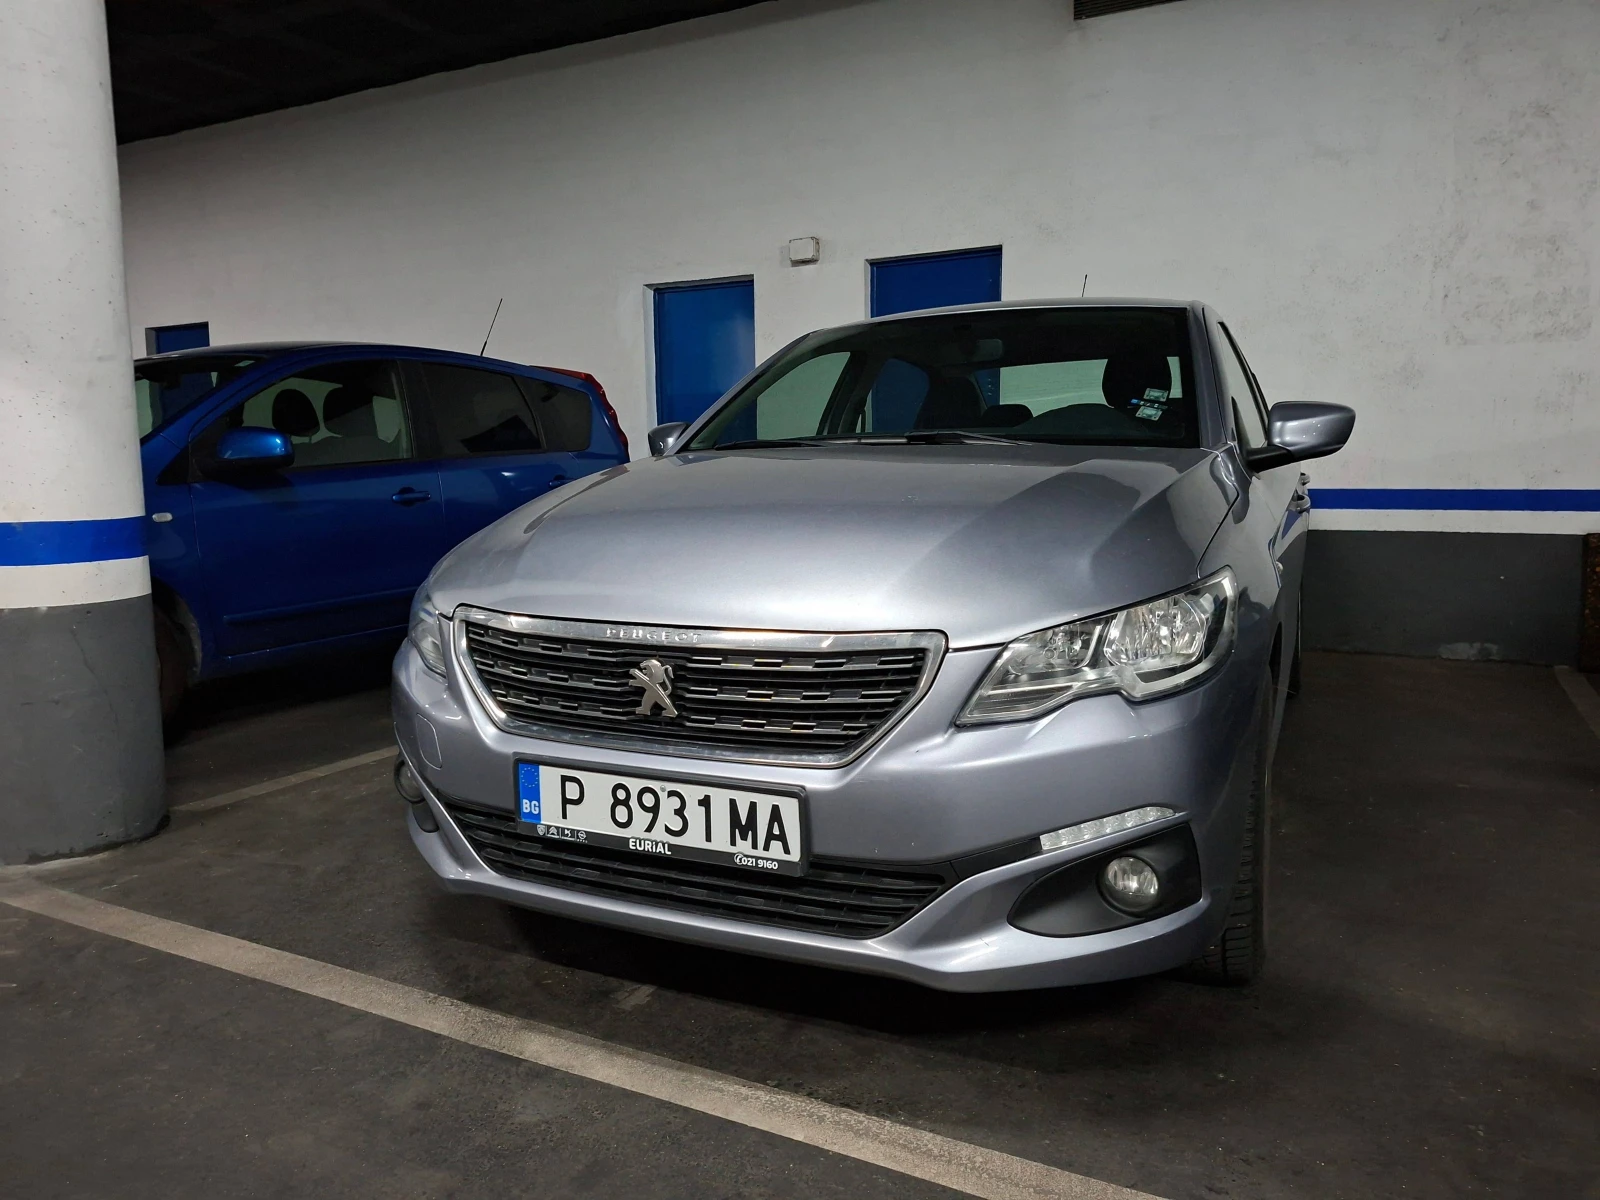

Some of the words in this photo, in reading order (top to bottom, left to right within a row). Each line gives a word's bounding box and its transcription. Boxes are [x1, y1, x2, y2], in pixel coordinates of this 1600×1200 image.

[605, 627, 702, 643] PEUGEOT
[522, 799, 540, 815] BG
[560, 774, 585, 820] P
[610, 783, 712, 843] 8931
[729, 798, 791, 855] MA
[757, 859, 778, 870] 9160
